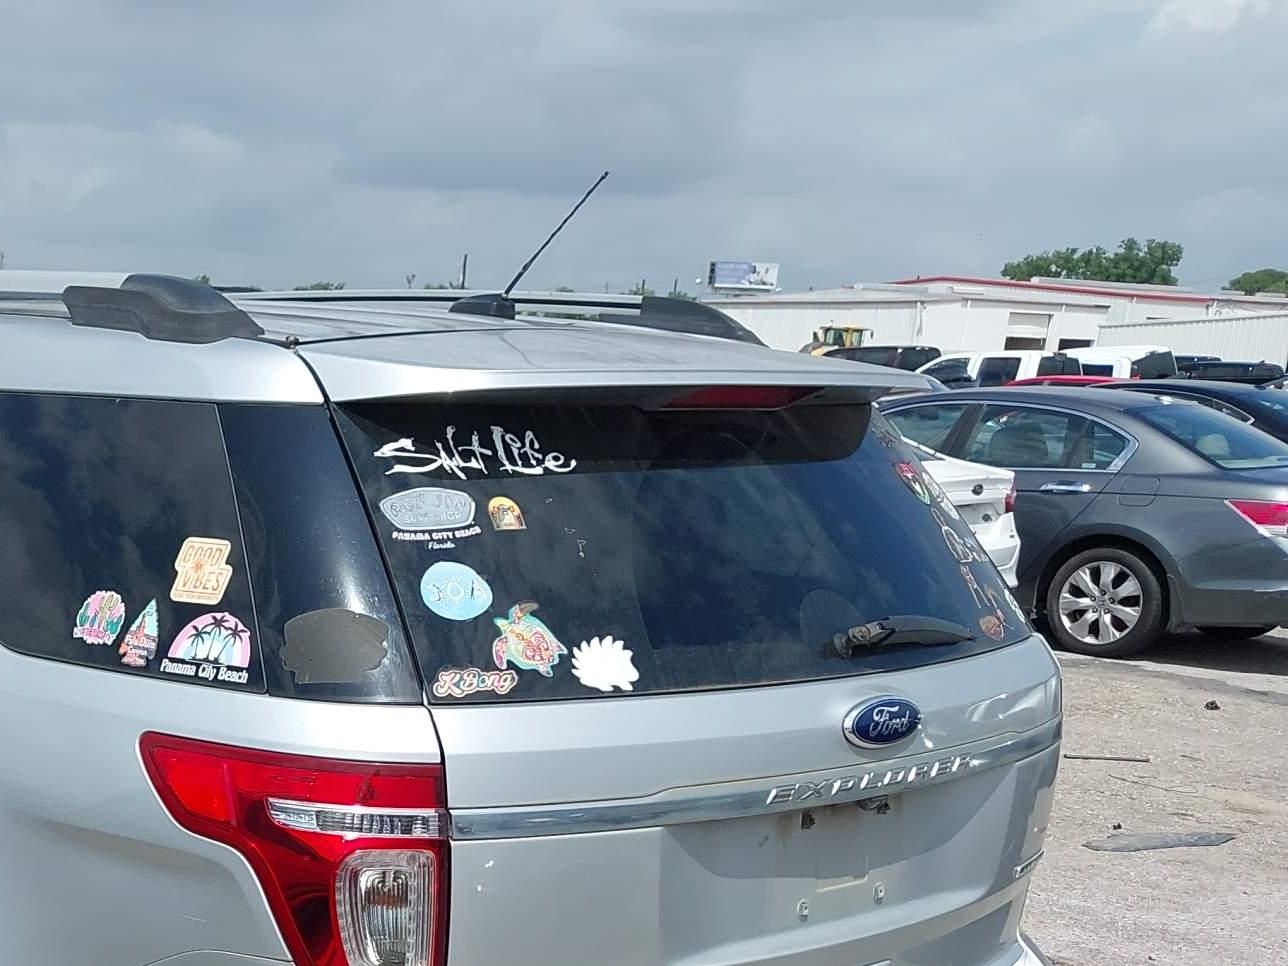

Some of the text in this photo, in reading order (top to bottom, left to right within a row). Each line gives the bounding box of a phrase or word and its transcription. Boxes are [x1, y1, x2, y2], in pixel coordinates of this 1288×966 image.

[431, 531, 454, 540] CITY
[183, 545, 224, 567] GOOD
[182, 567, 224, 592] VIBES
[160, 658, 197, 676] Panama
[198, 663, 217, 681] City
[217, 666, 249, 684] Beach
[869, 705, 910, 737] Ford
[766, 752, 974, 805] EXPLORER
